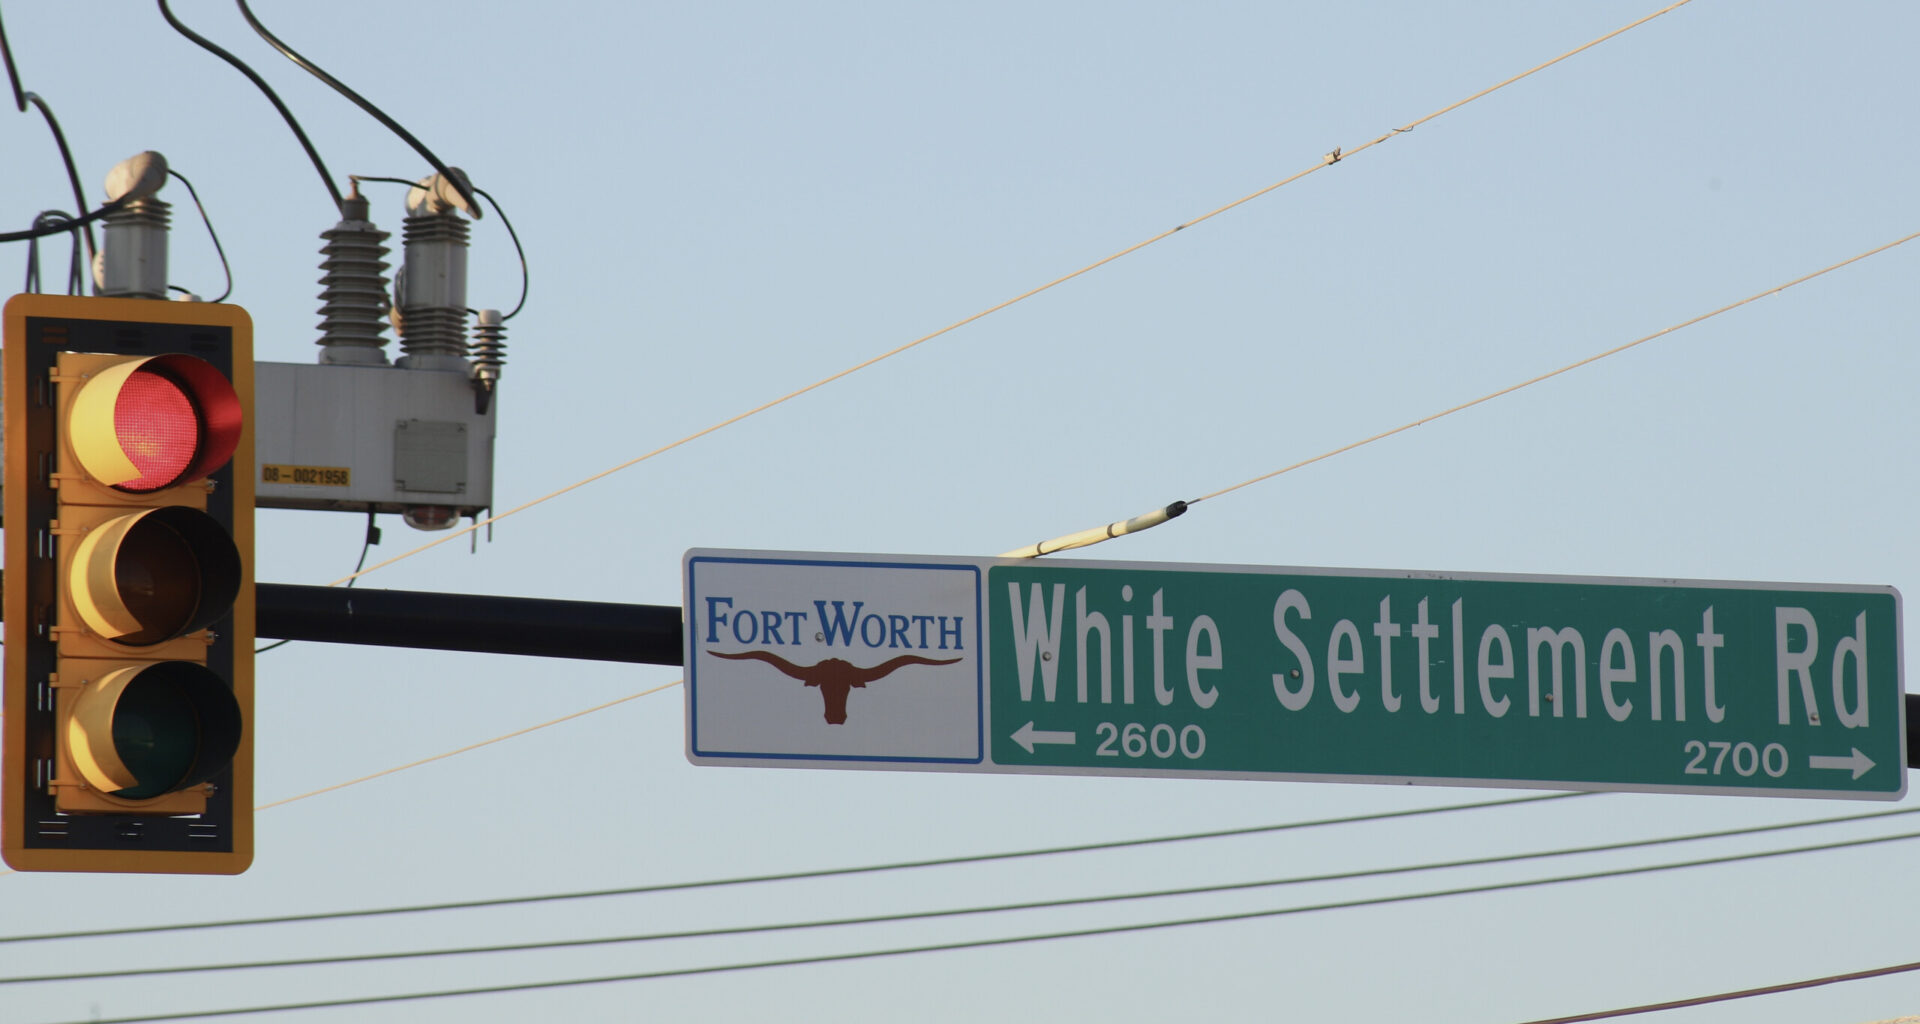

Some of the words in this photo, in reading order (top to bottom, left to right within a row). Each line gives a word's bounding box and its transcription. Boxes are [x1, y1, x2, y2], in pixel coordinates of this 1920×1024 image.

[705, 596, 807, 645] FORT
[813, 600, 963, 650] WORTH
[1008, 581, 1223, 709] White
[1272, 588, 1726, 723] Settlement
[1775, 606, 1870, 729] Rd
[1095, 722, 1206, 760] 2600
[1684, 740, 1789, 778] 2700
